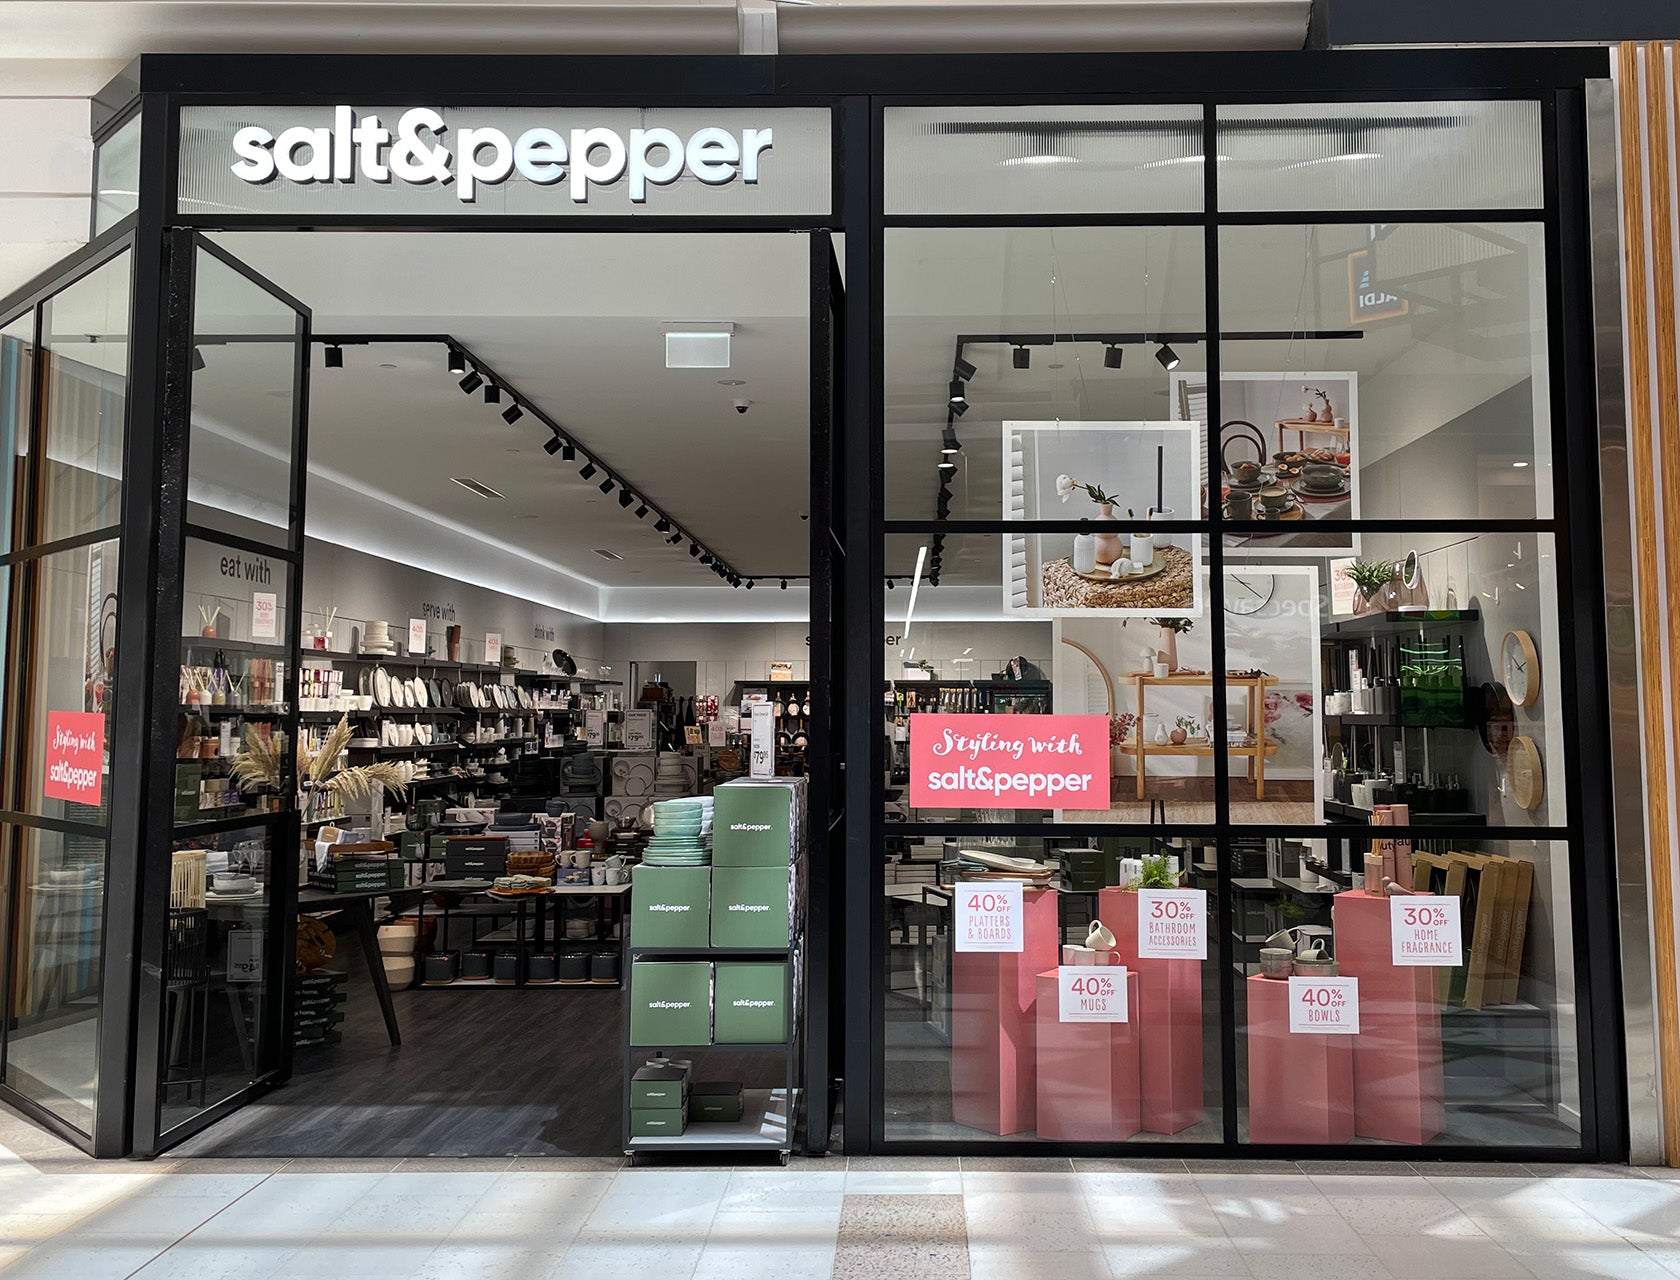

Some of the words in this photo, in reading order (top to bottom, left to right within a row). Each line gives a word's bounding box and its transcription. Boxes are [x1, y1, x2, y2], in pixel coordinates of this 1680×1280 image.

[231, 104, 773, 201] salt&pepper
[220, 555, 241, 579] eat
[244, 557, 271, 585] with
[422, 601, 440, 620] serve
[442, 603, 456, 622] with
[53, 725, 79, 755] Styling
[79, 731, 96, 752] with
[932, 728, 1025, 760] Styling
[1028, 733, 1083, 755] with
[50, 760, 97, 791] salt&pepper
[928, 765, 1092, 797] salt&pepper
[967, 894, 1008, 911] 40%
[1151, 901, 1191, 919] 30%
[968, 915, 1010, 927] PLATTERS
[1404, 907, 1445, 926] 30%
[967, 928, 975, 939] &
[978, 927, 1012, 940] BOARDS
[1149, 922, 1196, 934] BATHROOM
[1414, 929, 1439, 941] HOME
[1148, 935, 1197, 947] ACCESSORIES
[1401, 941, 1453, 953] FRAGRANCE
[1071, 977, 1112, 995] 40%
[1080, 999, 1107, 1011] MUGS
[1301, 988, 1343, 1006] 40%
[1308, 1009, 1341, 1023] BOWLS
